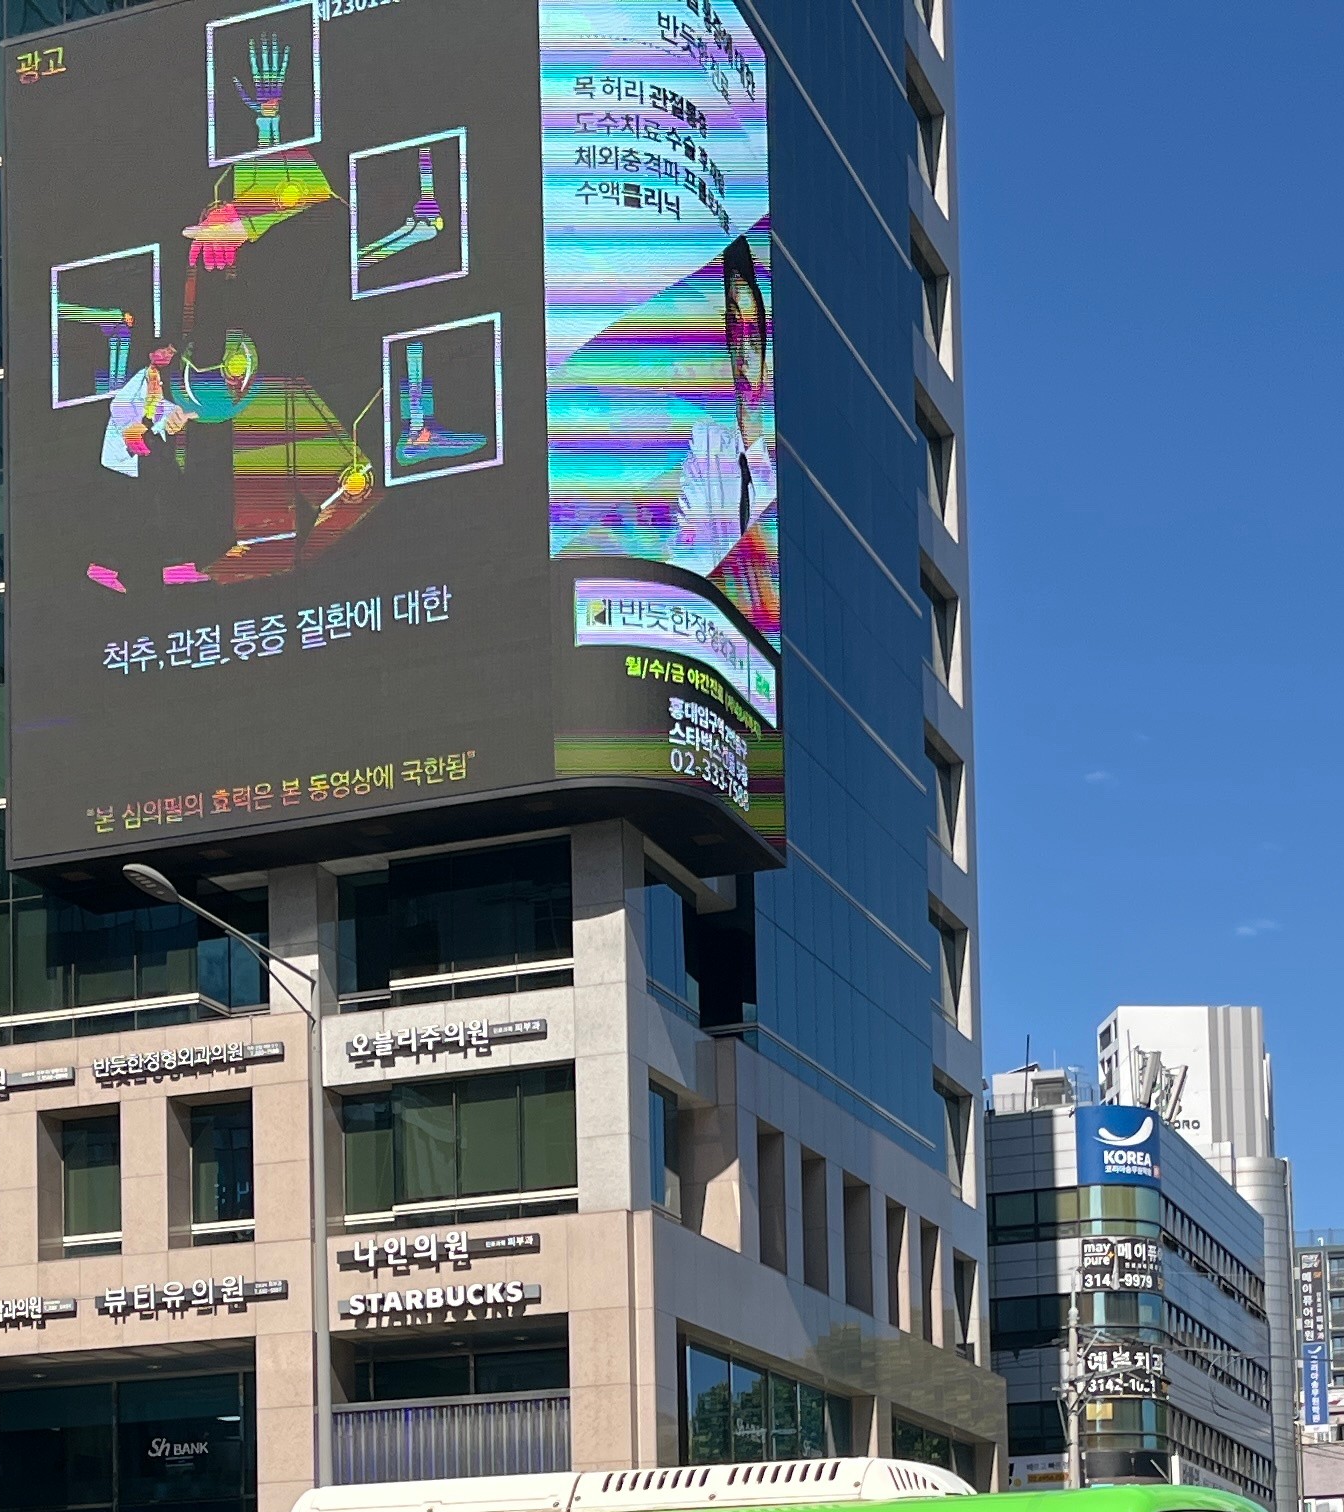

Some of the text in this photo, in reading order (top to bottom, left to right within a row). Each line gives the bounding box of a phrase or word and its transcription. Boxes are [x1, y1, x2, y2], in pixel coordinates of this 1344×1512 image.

[15, 46, 67, 84] 광고
[574, 76, 596, 98] 목
[602, 77, 645, 105] 허리
[574, 112, 662, 143] 도수치료
[575, 145, 680, 185] 체외충격파
[575, 180, 681, 221] 수액클리닉
[230, 613, 287, 661] 통증
[295, 594, 382, 650] 질환에
[393, 584, 453, 625] 대한
[281, 777, 302, 805] 본
[307, 763, 395, 801] 동영상에
[349, 1017, 489, 1059] 오블리주의원
[514, 1020, 541, 1033] 피부과
[93, 1041, 244, 1078] 반듯한정형외과의원
[1103, 1150, 1152, 1168] KOREA
[354, 1231, 469, 1268] 나인의원
[507, 1234, 534, 1247] 피부과
[1083, 1243, 1111, 1255] may
[1083, 1255, 1111, 1268] pure
[104, 1275, 245, 1315] 뷰티유의원
[349, 1280, 523, 1316] STARBUCKS
[1084, 1274, 1153, 1289] 314-9979
[147, 1438, 209, 1457] Sh BANK
